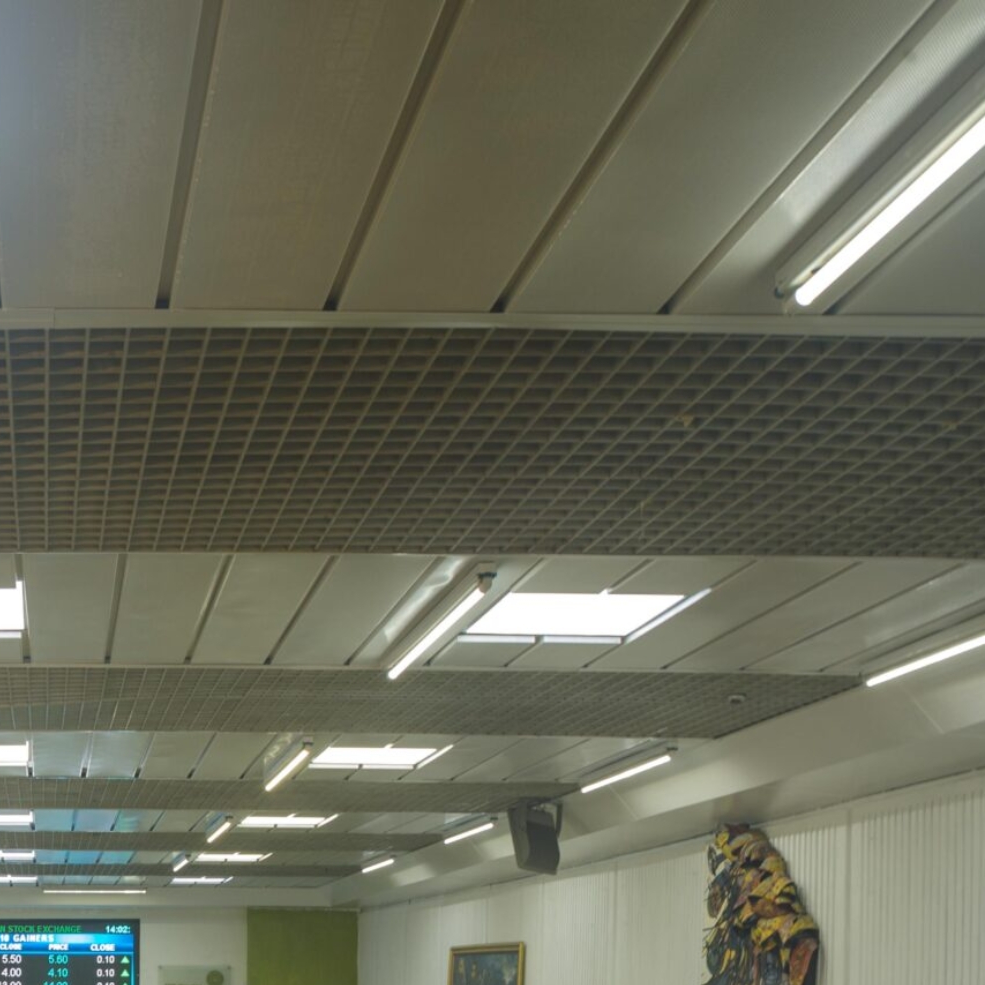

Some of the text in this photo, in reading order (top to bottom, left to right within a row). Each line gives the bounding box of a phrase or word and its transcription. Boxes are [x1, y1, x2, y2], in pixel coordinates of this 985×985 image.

[8, 925, 35, 933] STOCK
[37, 925, 82, 934] EXCHANGE
[13, 934, 55, 943] GAINERS
[0, 943, 23, 951] CLOSE
[48, 943, 69, 951] PRICE
[90, 943, 115, 951] CLOSE
[1, 954, 22, 964] 5.50
[96, 955, 115, 965] 0.10
[1, 968, 22, 977] 4.00
[48, 968, 68, 977] 4.10
[96, 969, 115, 978] 0.10
